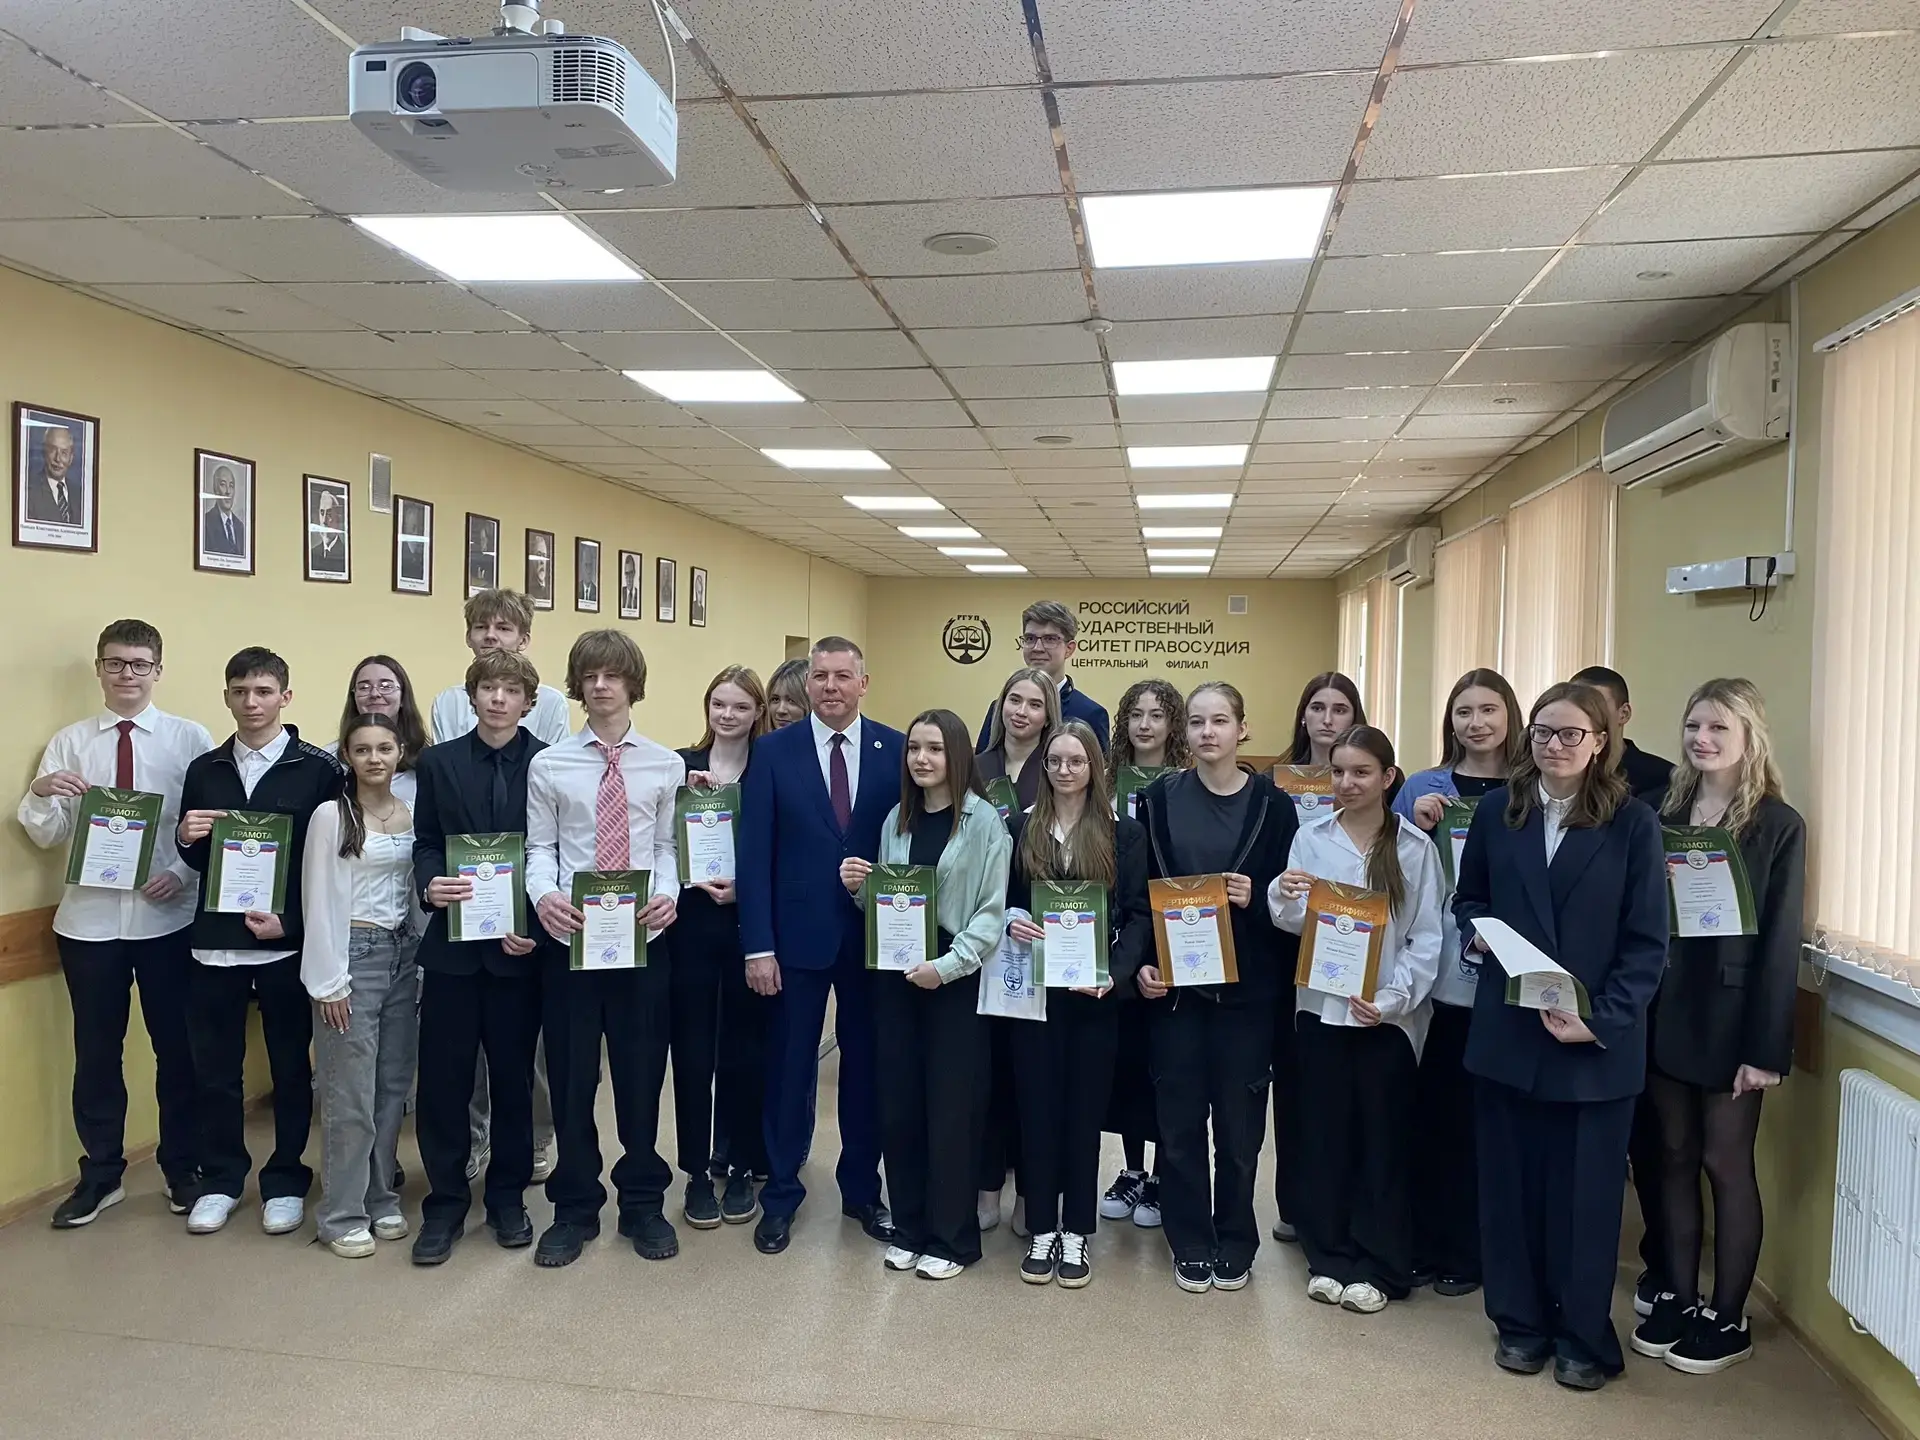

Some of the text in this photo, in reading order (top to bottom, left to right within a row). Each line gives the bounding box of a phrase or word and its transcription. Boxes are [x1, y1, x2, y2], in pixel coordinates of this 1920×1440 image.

[1079, 599, 1190, 615] РОССИЙСКИЙ
[1077, 619, 1214, 635] УДАРСТВЕННЫЙ
[1134, 640, 1250, 656] ПРАВОСУДИЯ
[1071, 658, 1209, 669] ЦЕНТРАЛЬНЫЙ ФИЛИАЛ
[691, 802, 726, 810] ГРАМОТА
[100, 806, 141, 817] ГРАМОТА
[232, 830, 272, 839] ГРАМОТА
[1671, 841, 1715, 849] ГРАМОТА
[465, 853, 506, 862] ГРАМОТА
[591, 884, 630, 892] ГРАМОТА
[883, 884, 920, 892] ГРАМОТА
[1050, 901, 1089, 910] ГРАМОТА
